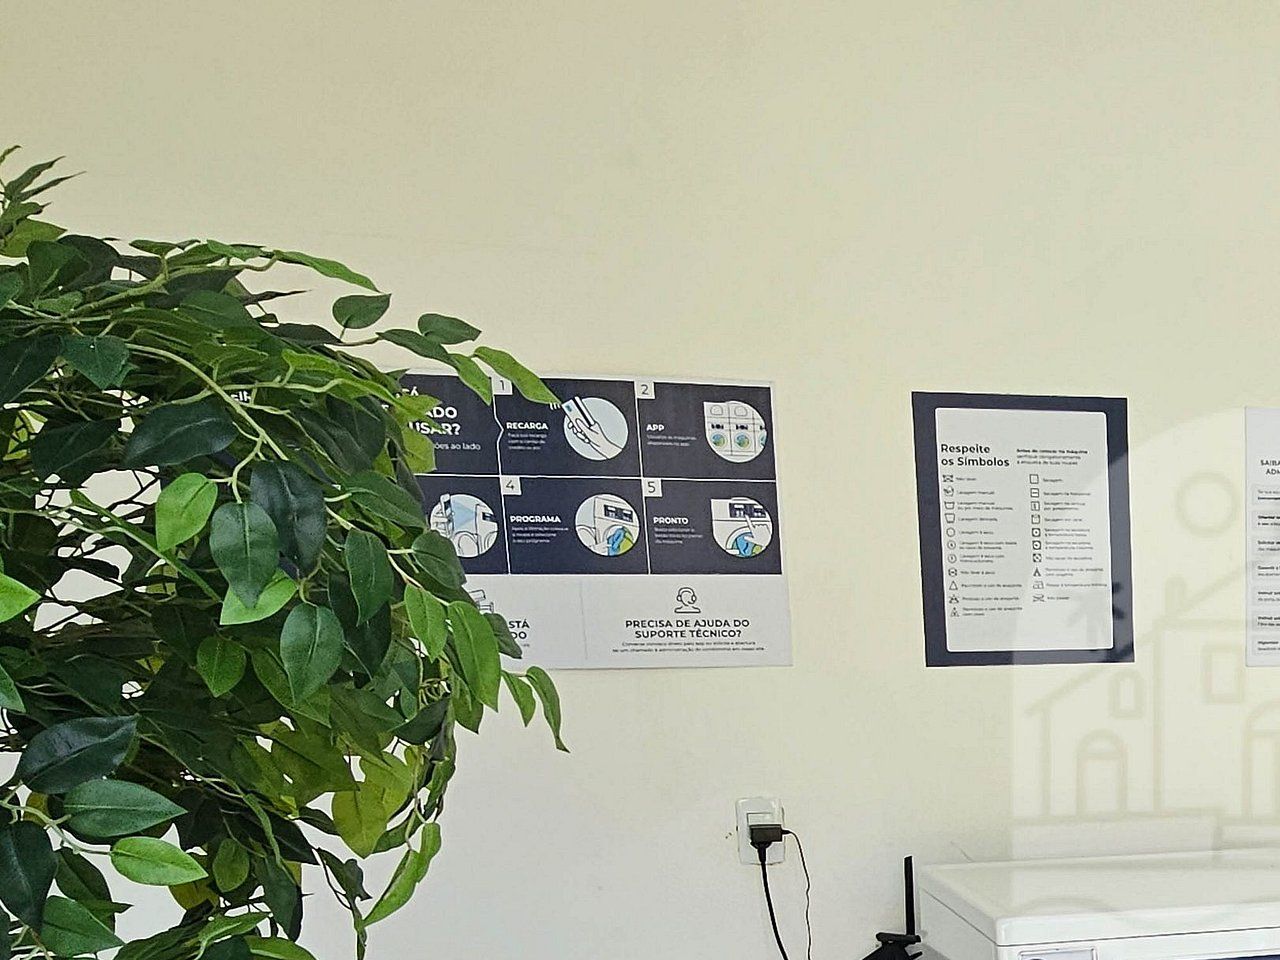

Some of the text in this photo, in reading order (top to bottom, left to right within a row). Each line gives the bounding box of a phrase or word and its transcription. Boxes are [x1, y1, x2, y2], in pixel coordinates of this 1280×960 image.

[499, 379, 505, 391] 1
[640, 384, 649, 395] 2
[506, 421, 549, 431] RECARGA
[646, 424, 665, 432] APP
[462, 442, 481, 450] lado
[940, 443, 991, 455] Respeite
[941, 458, 955, 466] os
[957, 456, 1010, 467] Símbolos
[505, 480, 515, 491] 4
[647, 481, 656, 493] 5
[509, 515, 562, 524] PROGRAMA
[652, 516, 689, 525] PRONTO
[625, 619, 750, 628] PRECISA DE AJUDA DO
[634, 628, 742, 638] SUPORTE TÉCNICO?
